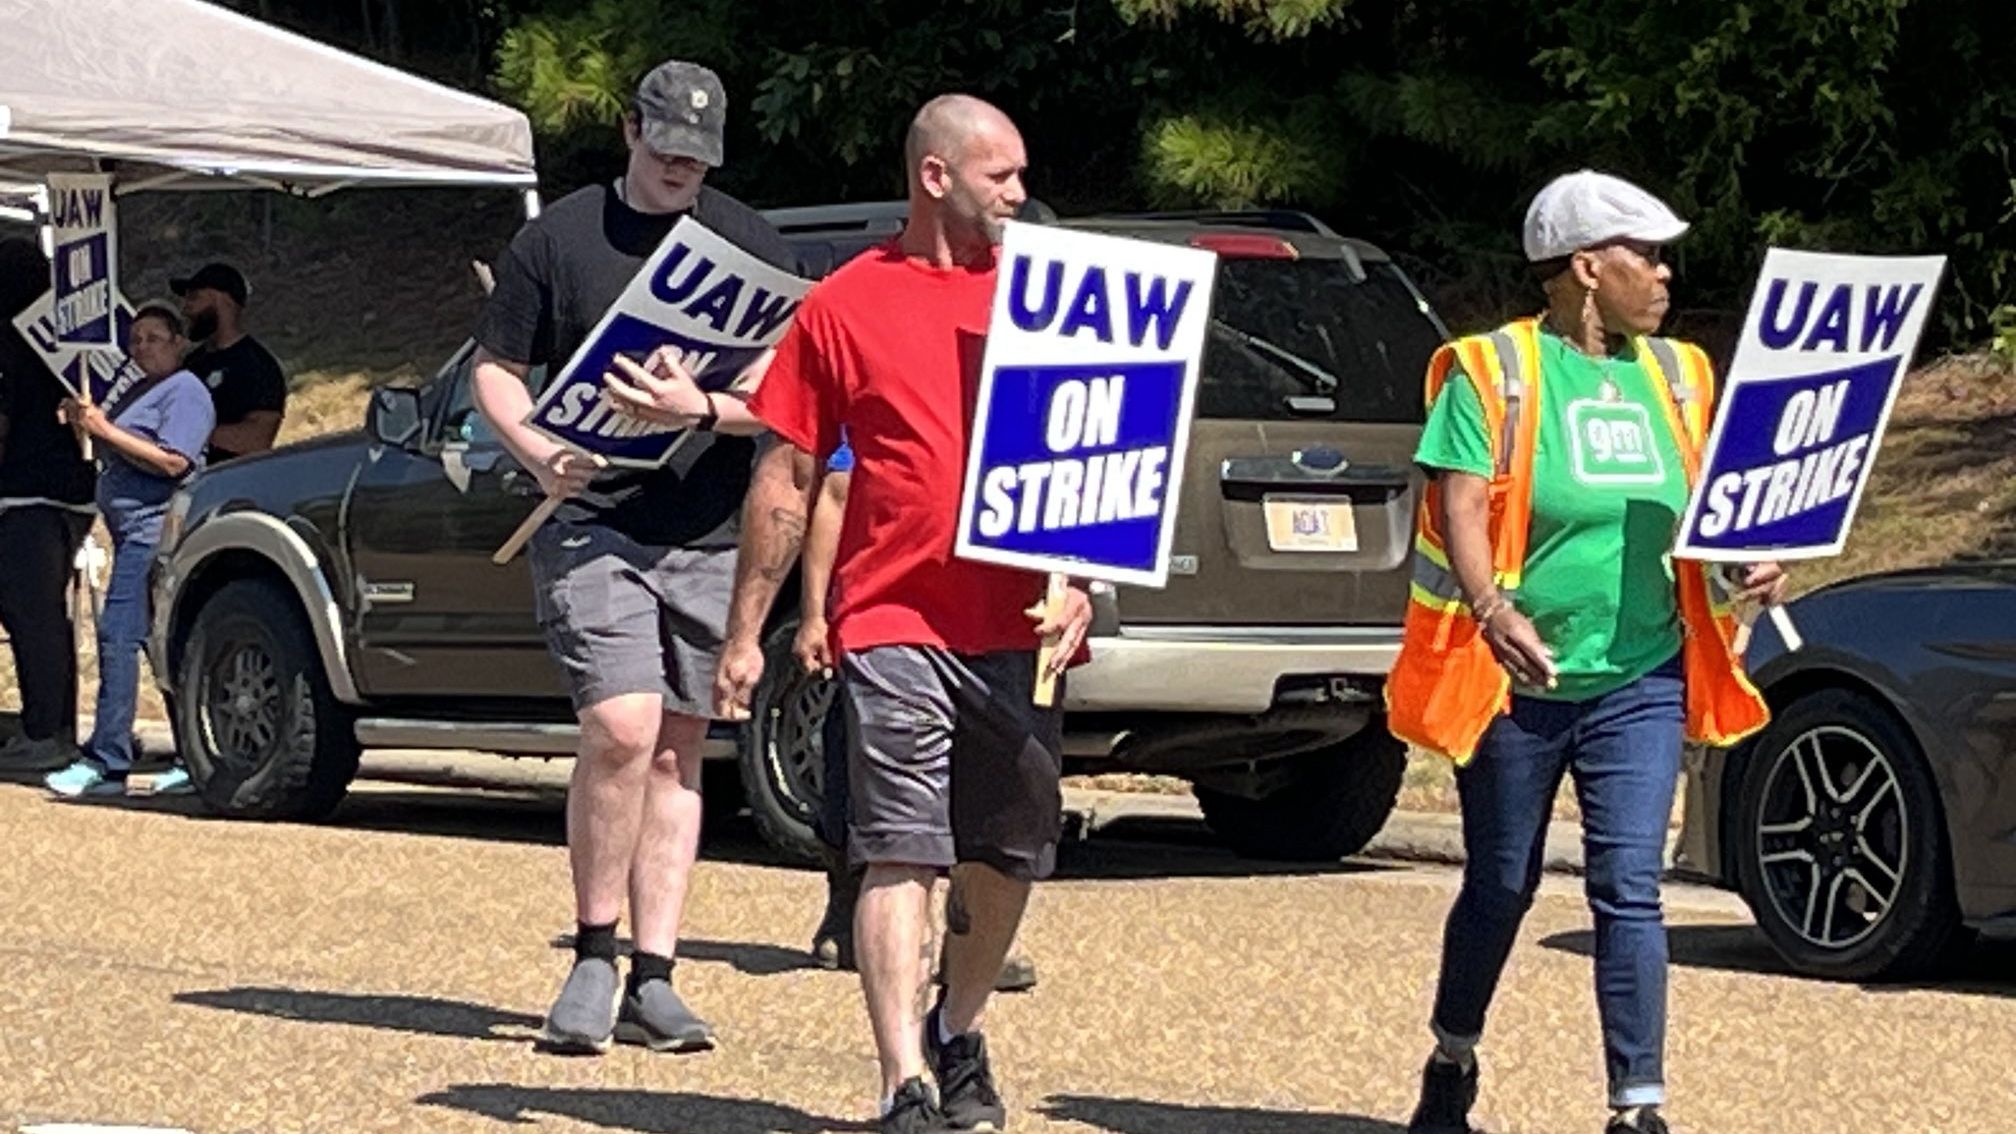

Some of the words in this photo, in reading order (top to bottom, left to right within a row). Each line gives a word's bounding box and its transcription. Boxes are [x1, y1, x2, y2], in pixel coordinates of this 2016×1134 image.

[53, 188, 103, 229] UAW
[650, 242, 804, 341] UAW
[1008, 254, 1195, 352] UAW
[1758, 278, 1925, 353] UAW
[1045, 374, 1126, 454] ON
[1587, 417, 1647, 463] gm
[1773, 379, 1851, 456] ON
[978, 445, 1167, 538] STRIKE
[1699, 433, 1870, 538] STRIKE
